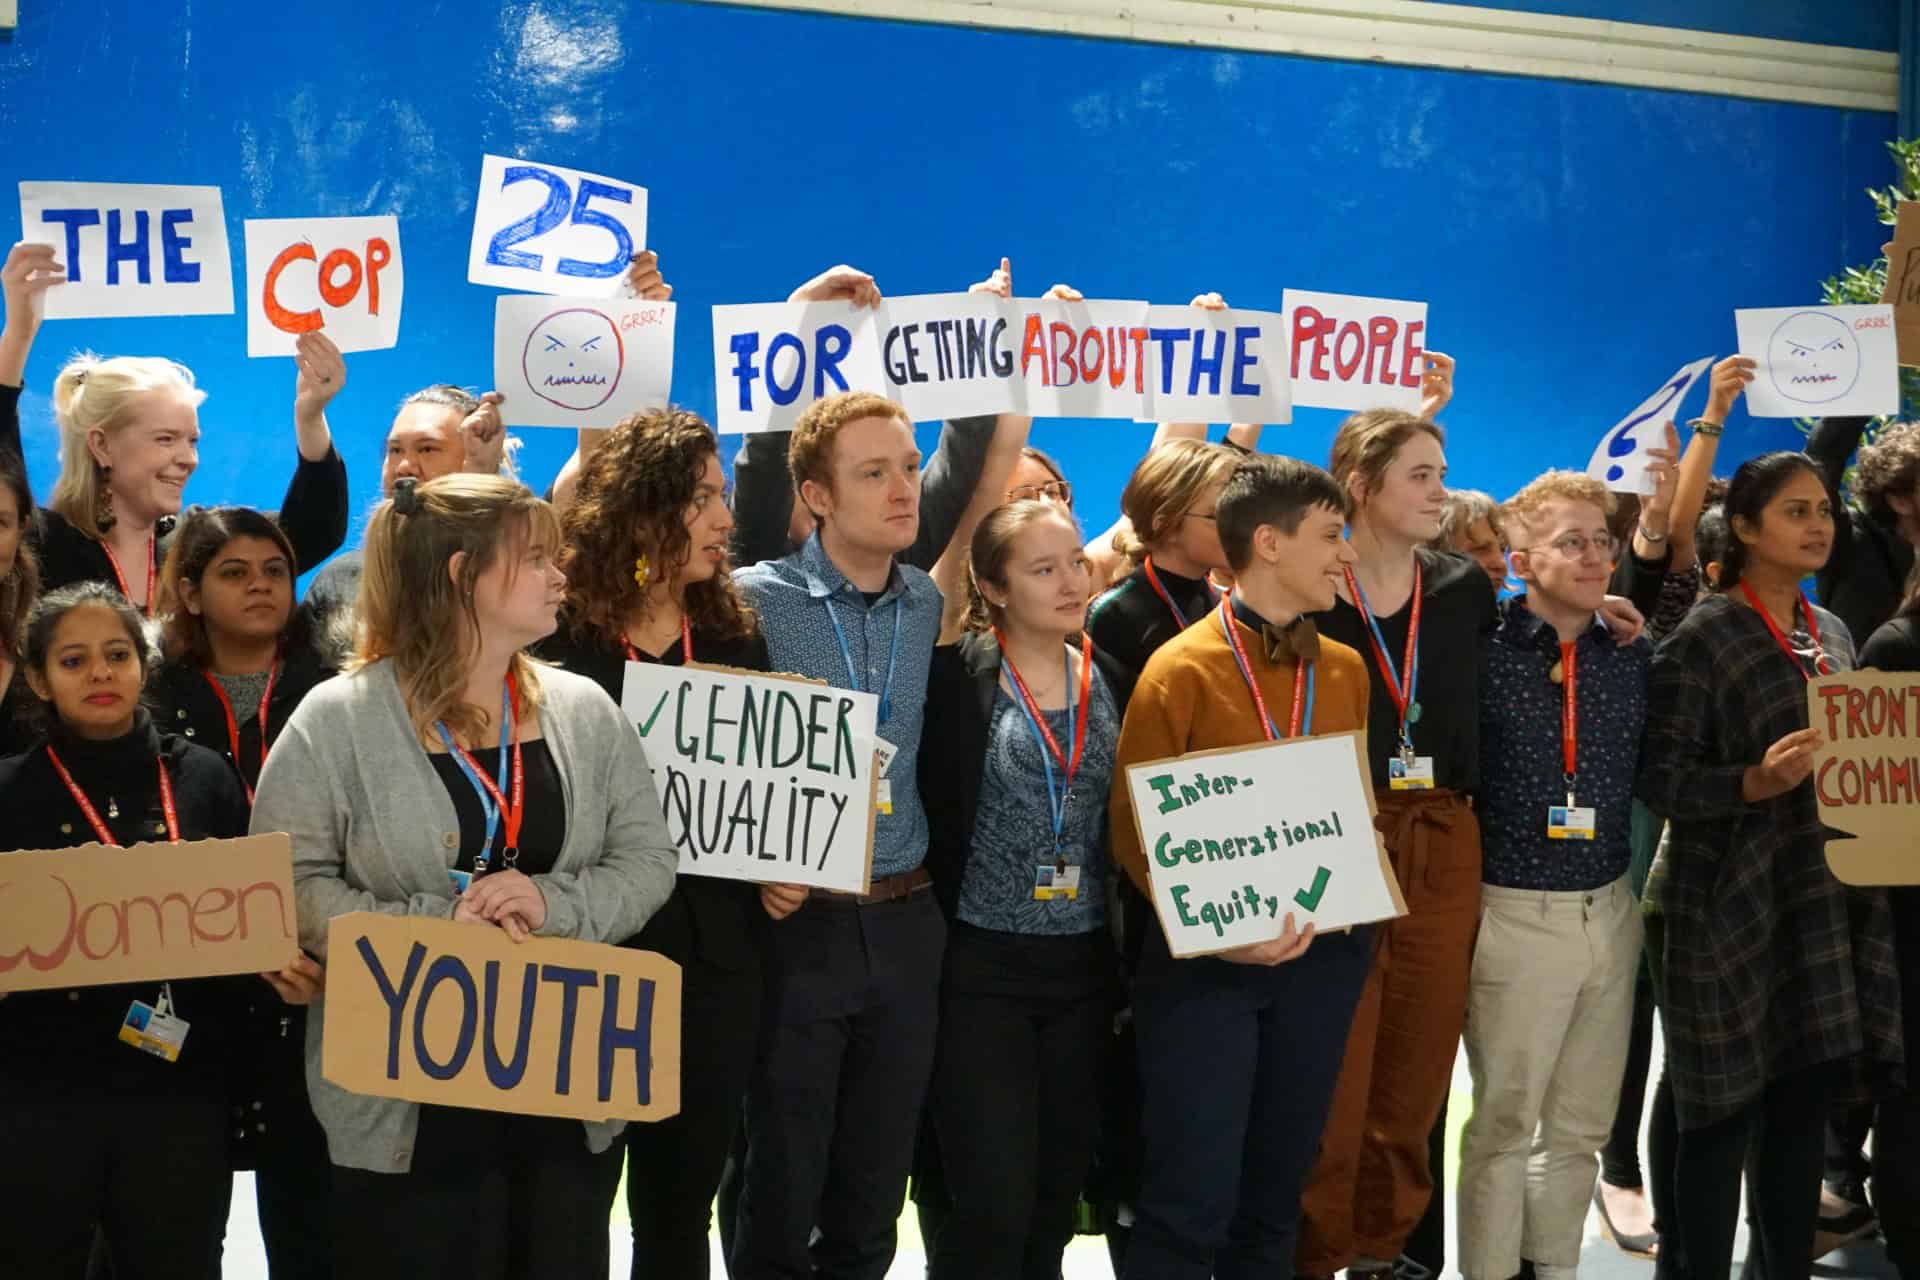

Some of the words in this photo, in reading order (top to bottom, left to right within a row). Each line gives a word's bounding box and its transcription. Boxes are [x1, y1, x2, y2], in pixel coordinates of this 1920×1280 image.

[42, 208, 201, 285] THE
[486, 166, 634, 279] 25
[262, 236, 390, 333] COP
[731, 324, 852, 413] FOR
[883, 317, 1013, 386] GETTING
[1021, 312, 1150, 394] ABOUT
[1149, 326, 1261, 396] THE
[1291, 305, 1424, 388] PEOPLE
[675, 680, 856, 779] GENDER
[650, 765, 849, 871] QUALiTY
[1146, 773, 1254, 815] Inter-
[1154, 811, 1343, 868] Generational
[1170, 884, 1278, 937] Equity
[355, 935, 655, 1106] YOUTH
